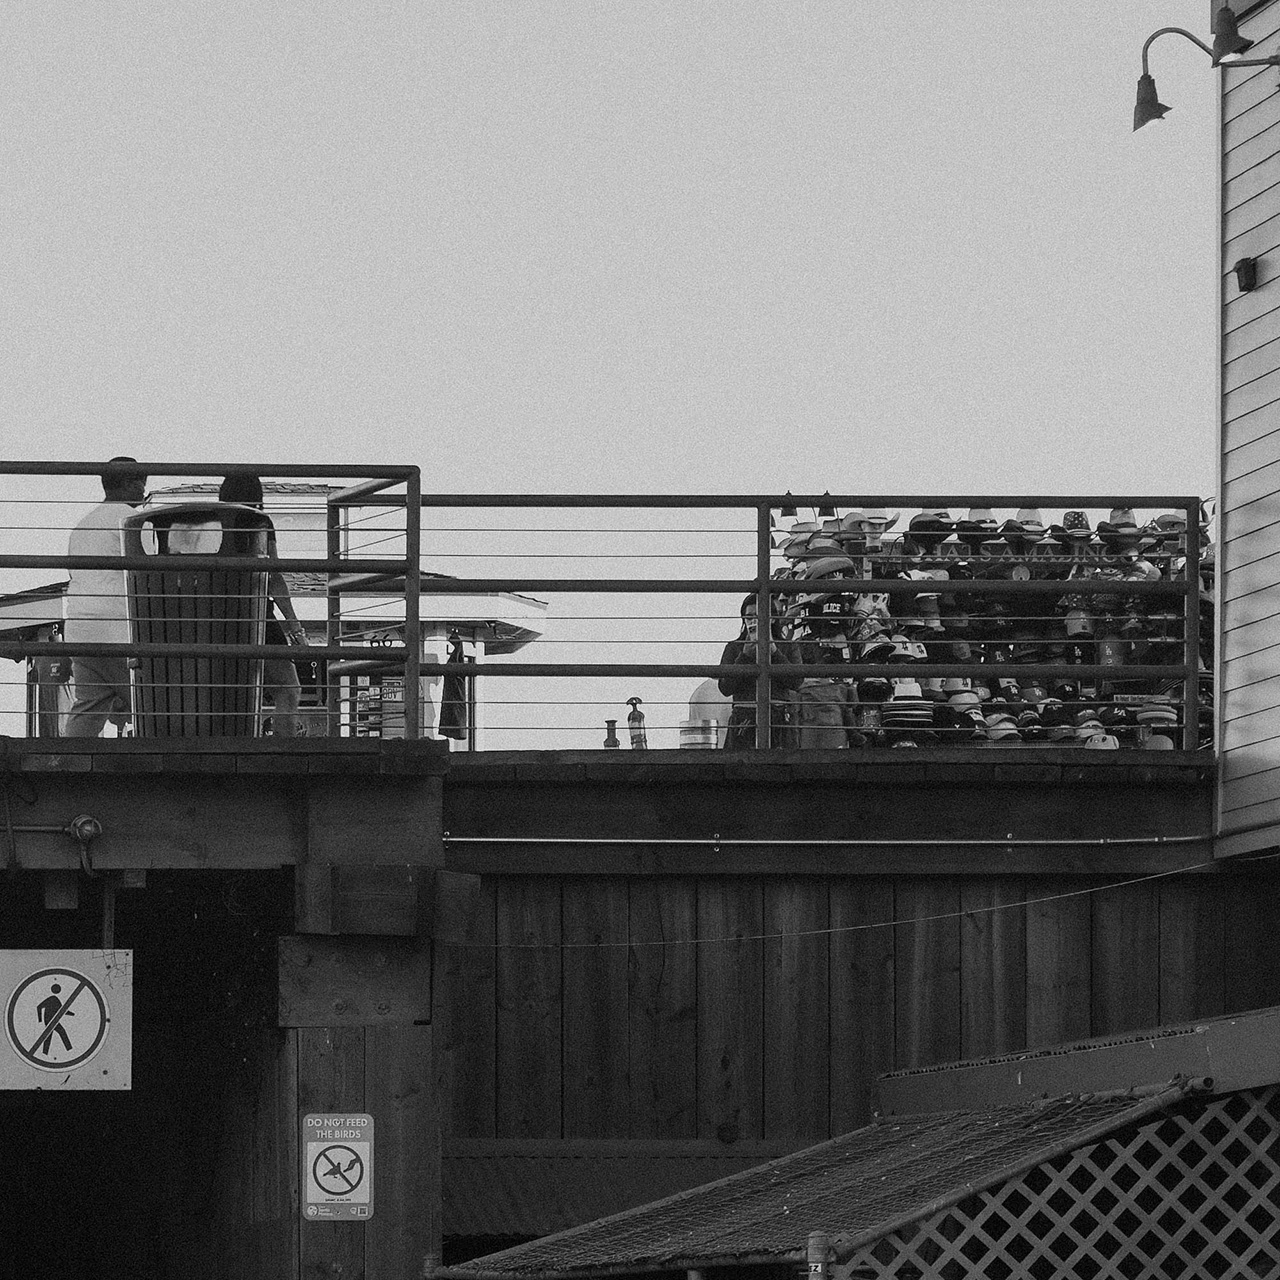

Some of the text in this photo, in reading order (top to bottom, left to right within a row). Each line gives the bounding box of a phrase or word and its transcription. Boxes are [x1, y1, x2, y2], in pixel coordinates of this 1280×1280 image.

[307, 1118, 368, 1127] DO NOT FEED
[315, 1130, 361, 1139] THE BIRDS
